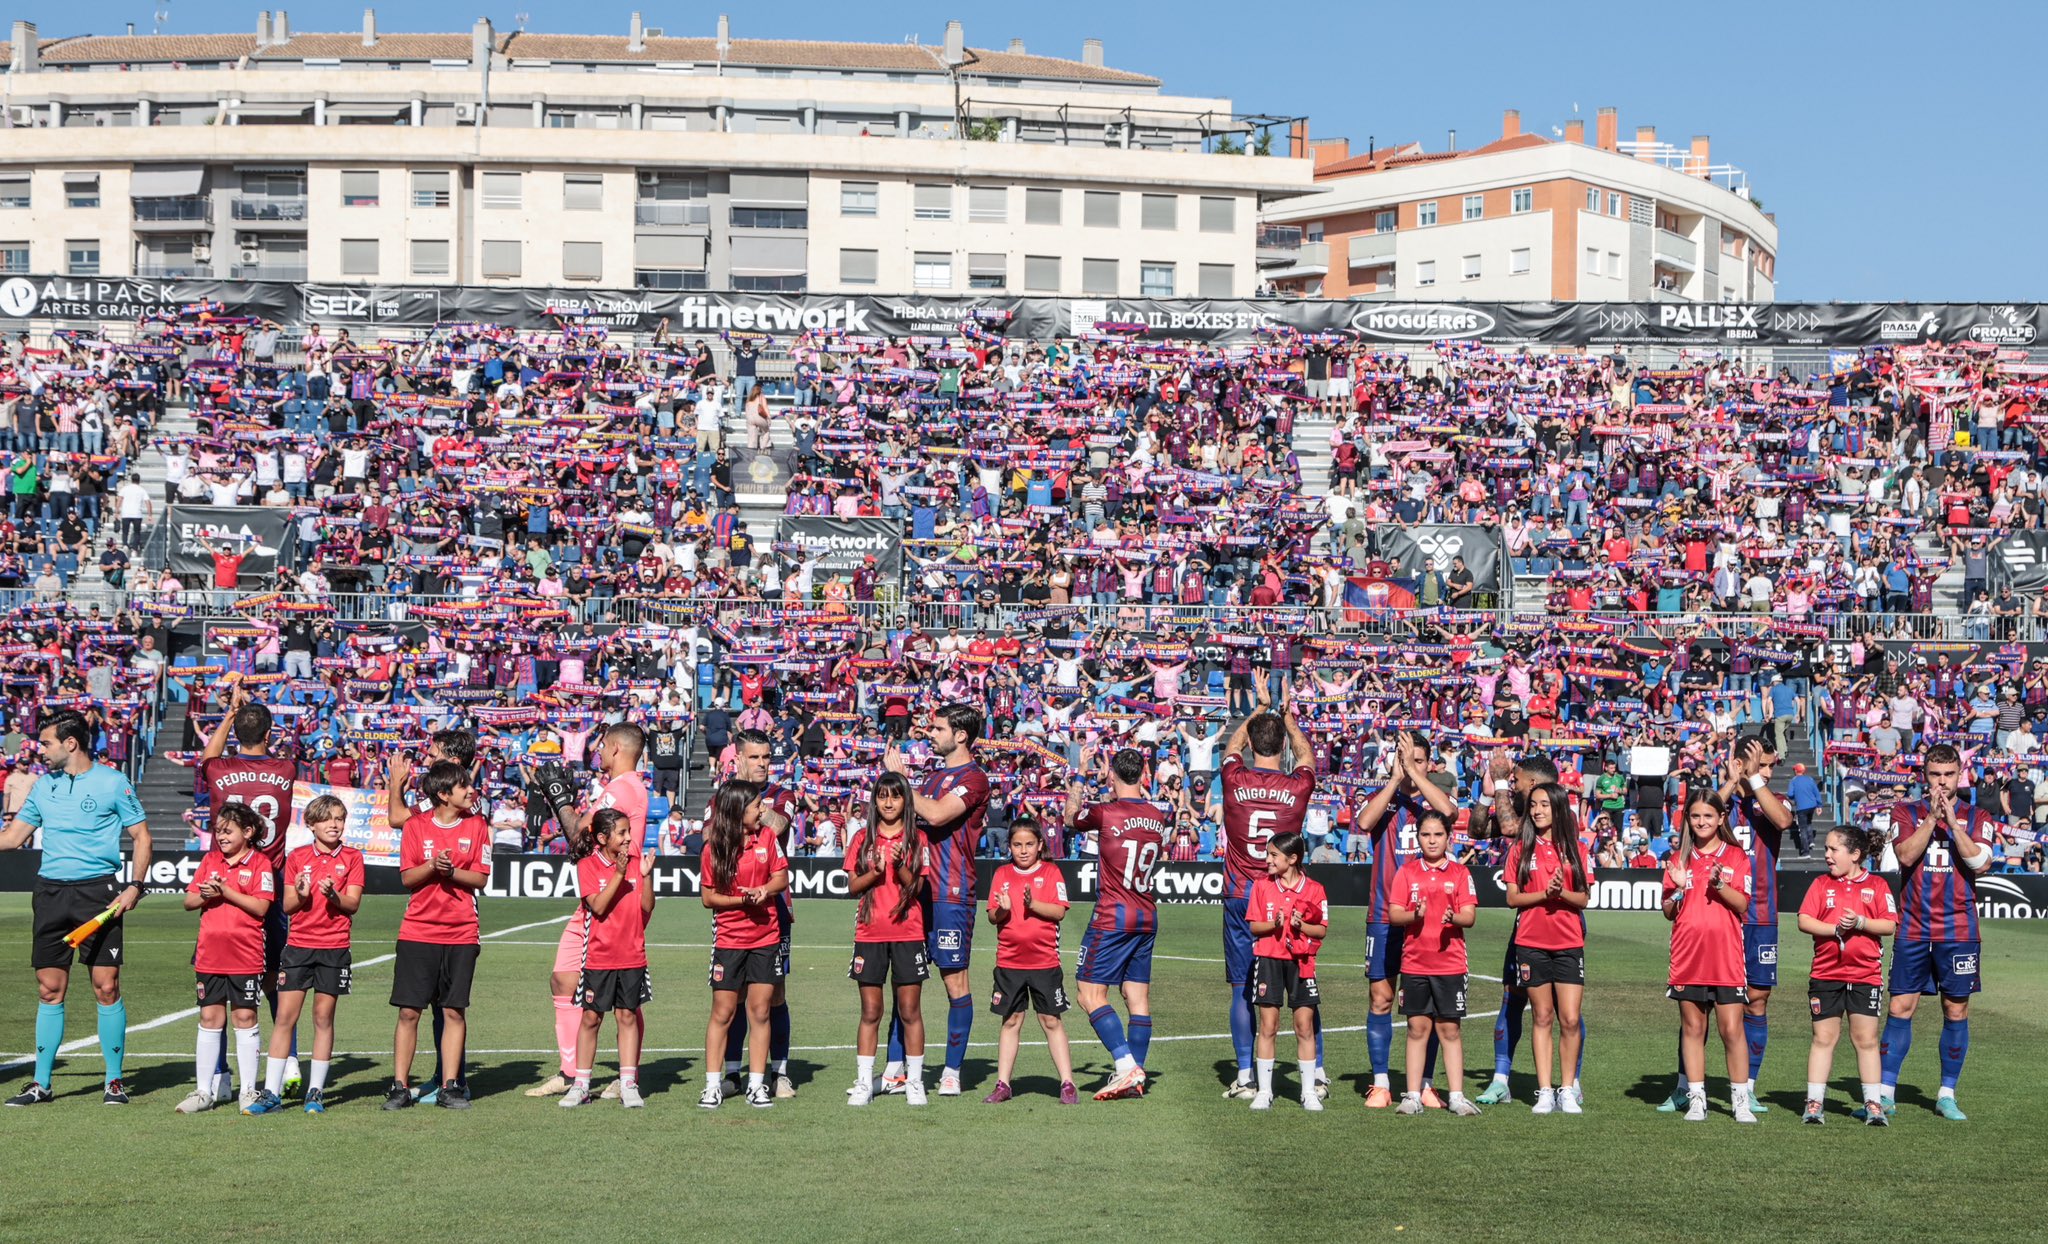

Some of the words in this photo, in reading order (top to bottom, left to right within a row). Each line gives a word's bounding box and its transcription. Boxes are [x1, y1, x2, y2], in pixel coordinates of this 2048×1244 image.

[40, 282, 176, 303] ALIPACK
[40, 303, 91, 315] ARTES
[377, 300, 399, 308] Radio
[594, 299, 606, 313] Y
[608, 297, 656, 313] MÓVIL
[893, 306, 938, 319] FIBRA
[941, 306, 952, 318] Y
[616, 314, 639, 325] 1777
[680, 297, 870, 332] finetwork
[1111, 311, 1168, 329] MAIL
[1170, 313, 1234, 329] BOXES
[1369, 313, 1478, 330] NOGUERAS
[1660, 306, 1758, 328] PALLEX
[911, 322, 931, 331] LLAMA
[932, 322, 952, 331] GRATIS
[1726, 329, 1758, 339] IBERIA
[1883, 323, 1917, 331] PAASA
[1972, 327, 2033, 337] PROALPE
[790, 532, 889, 549] finetwork
[215, 771, 257, 791] PEDRO
[259, 772, 291, 791] CAPÓ
[1234, 787, 1268, 802] ÍÑIGO
[1269, 789, 1297, 807] PIÑA
[226, 794, 279, 847] 8
[1110, 825, 1124, 837] J.
[1123, 817, 1165, 837] JORQUER
[1246, 810, 1277, 860] 5
[1121, 839, 1159, 893] 19
[938, 935, 960, 946] CRC
[1956, 960, 1977, 970] CRC
